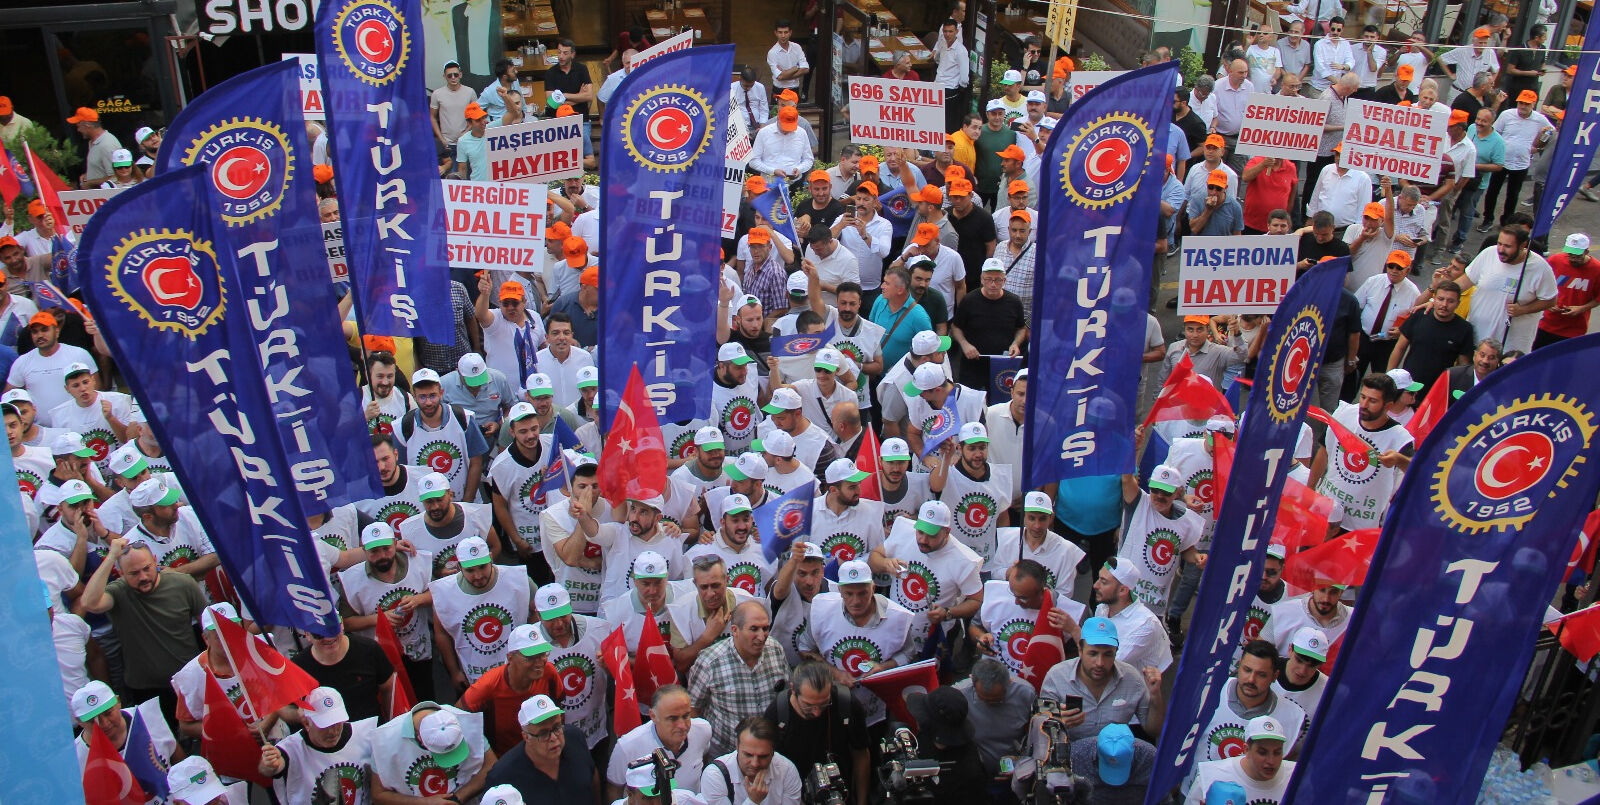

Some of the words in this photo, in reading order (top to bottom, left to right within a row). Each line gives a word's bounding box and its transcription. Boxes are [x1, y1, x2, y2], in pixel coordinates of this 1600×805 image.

[205, 0, 319, 34] SHO
[346, 8, 398, 32] TÜRK-İŞ
[359, 62, 396, 77] 1952
[850, 82, 884, 100] 696
[889, 85, 943, 106] SAYILI
[638, 96, 700, 117] TÜRK-İŞ
[879, 104, 916, 123] KHK
[1245, 104, 1326, 127] SERVİSİME
[1362, 104, 1433, 130] VERGİDE
[487, 123, 582, 152] TAŞERONA
[851, 124, 944, 146] KALDIRILSIN
[1078, 124, 1140, 152] TÜRK-İŞ
[1239, 127, 1319, 150] DOKUNMA
[1345, 122, 1443, 156] ADALET
[200, 132, 275, 165] TÜRK-İŞ
[648, 150, 688, 163] 1952
[491, 148, 579, 181] HAYIR!
[1347, 148, 1432, 180] İSTİYORUZ
[448, 183, 530, 206] VERGİDE
[1084, 181, 1126, 198] 1952
[223, 191, 273, 214] 1952
[367, 101, 419, 330] TÜRK-İŞ
[1183, 247, 1295, 271] TAŞERONA
[642, 189, 684, 416] TÜRK-İŞ
[1183, 278, 1289, 304] HAYIR!
[162, 305, 212, 326] 1952
[1060, 226, 1122, 467] TÜRK-İŞ
[1471, 413, 1573, 449] TÜRK-İŞ
[1466, 497, 1533, 518] 1952
[1360, 558, 1499, 805] TÜRK-İ
